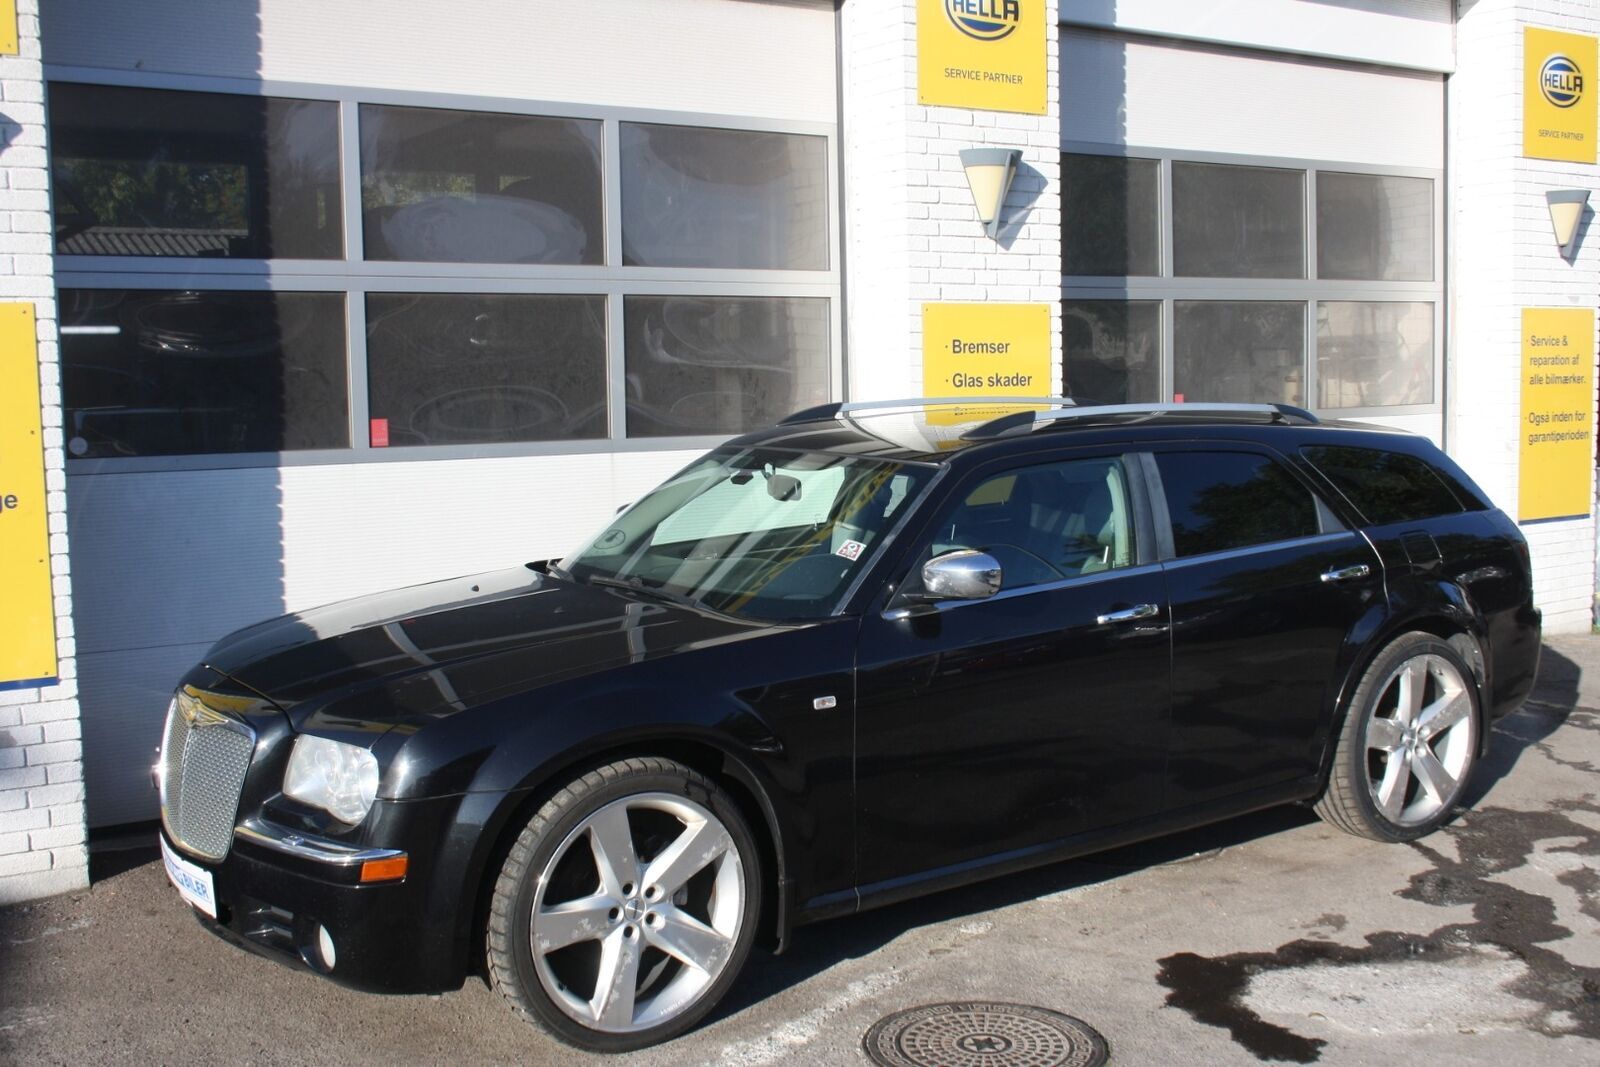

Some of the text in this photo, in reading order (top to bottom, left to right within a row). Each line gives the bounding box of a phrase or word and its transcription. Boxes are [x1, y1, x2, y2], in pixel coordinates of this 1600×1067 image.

[953, 0, 1019, 21] HELLA
[944, 68, 1023, 84] SERVICE PARTNER
[1544, 74, 1583, 92] HELLA
[1538, 129, 1584, 141] SERVICE PARTNER
[952, 339, 1010, 354] Bremser
[1530, 335, 1568, 347] Service &
[1530, 354, 1580, 367] reparation af
[952, 373, 1032, 387] Glas skader
[1529, 374, 1586, 385] alle bilmærker.
[1528, 411, 1585, 426] Også inden for
[1528, 430, 1589, 445] garantiperioden
